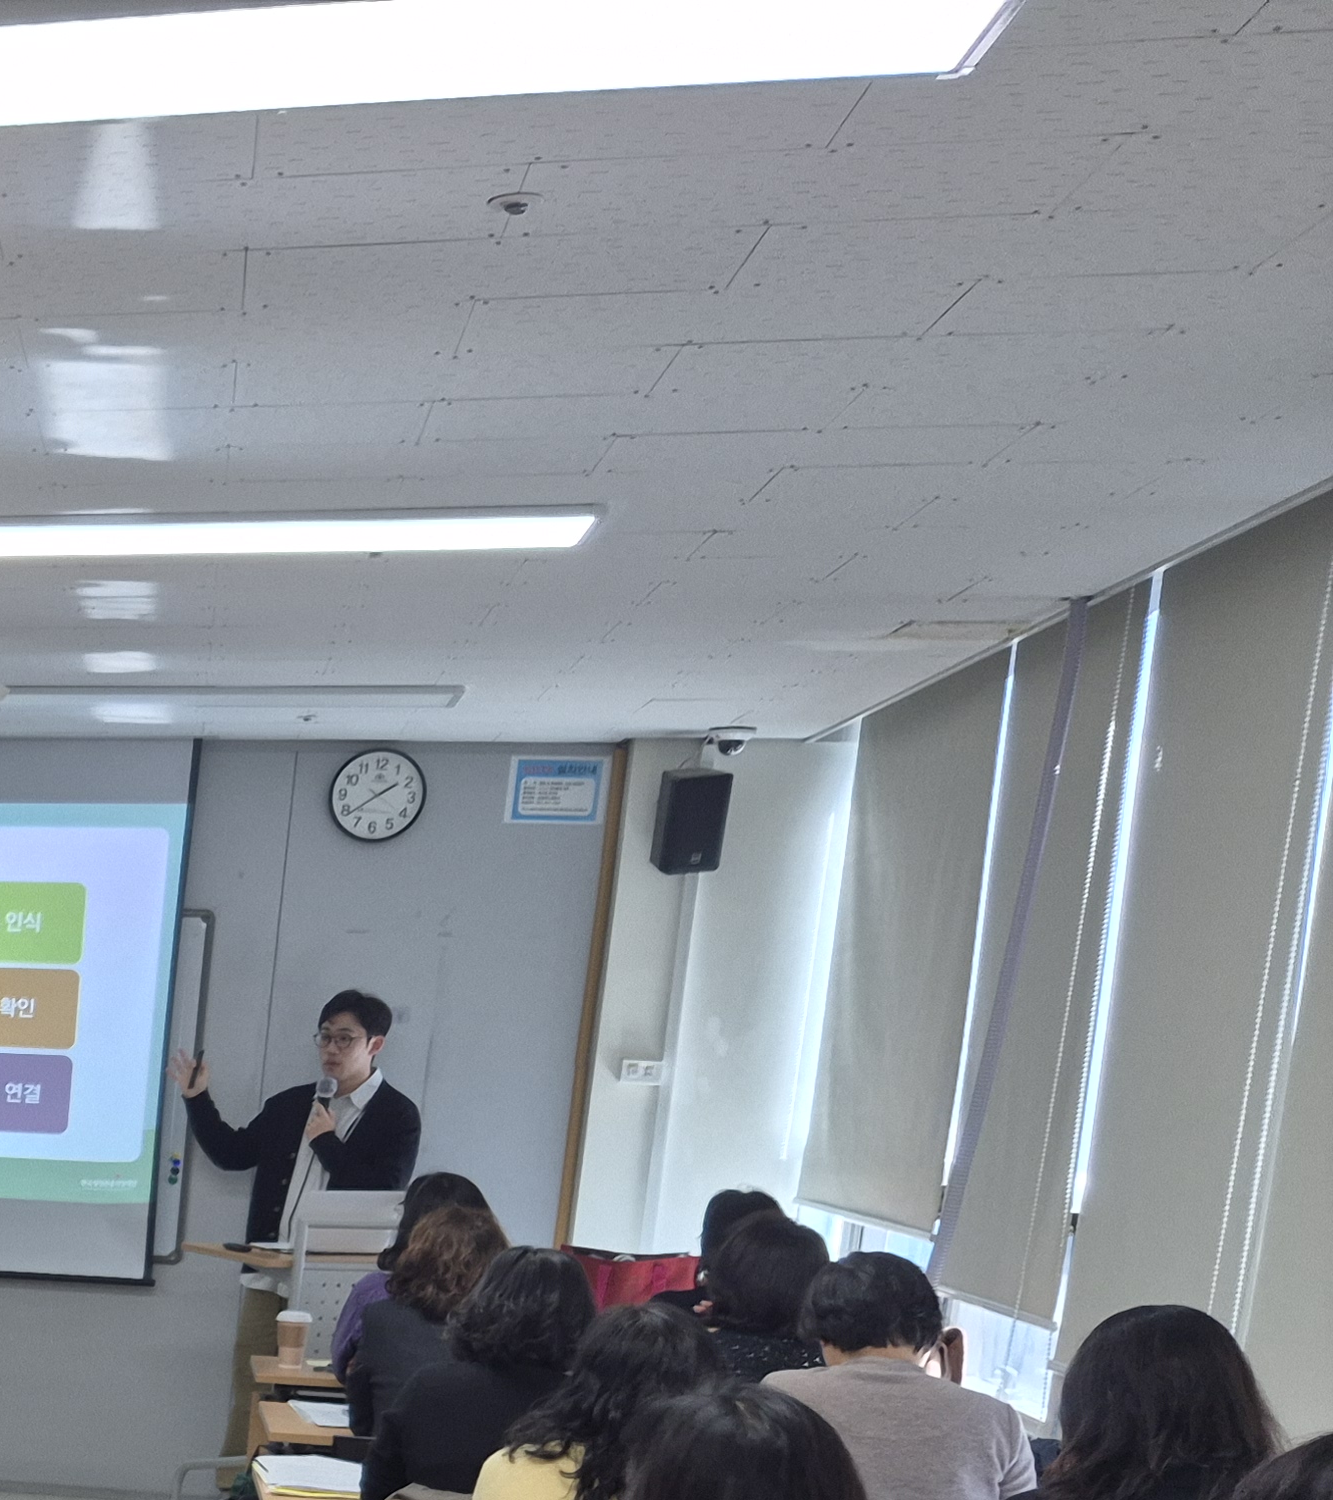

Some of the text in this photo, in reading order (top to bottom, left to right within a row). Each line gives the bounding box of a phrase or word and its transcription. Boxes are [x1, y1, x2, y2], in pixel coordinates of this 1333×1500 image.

[359, 756, 401, 776] 11 12 1
[346, 774, 413, 789] 10 2
[339, 788, 416, 804] 9 3
[341, 804, 407, 818] 8 4
[354, 816, 394, 834] 7 6 5
[5, 911, 44, 933] 인식
[0, 996, 35, 1018] 확인
[5, 1083, 41, 1104] 연결
